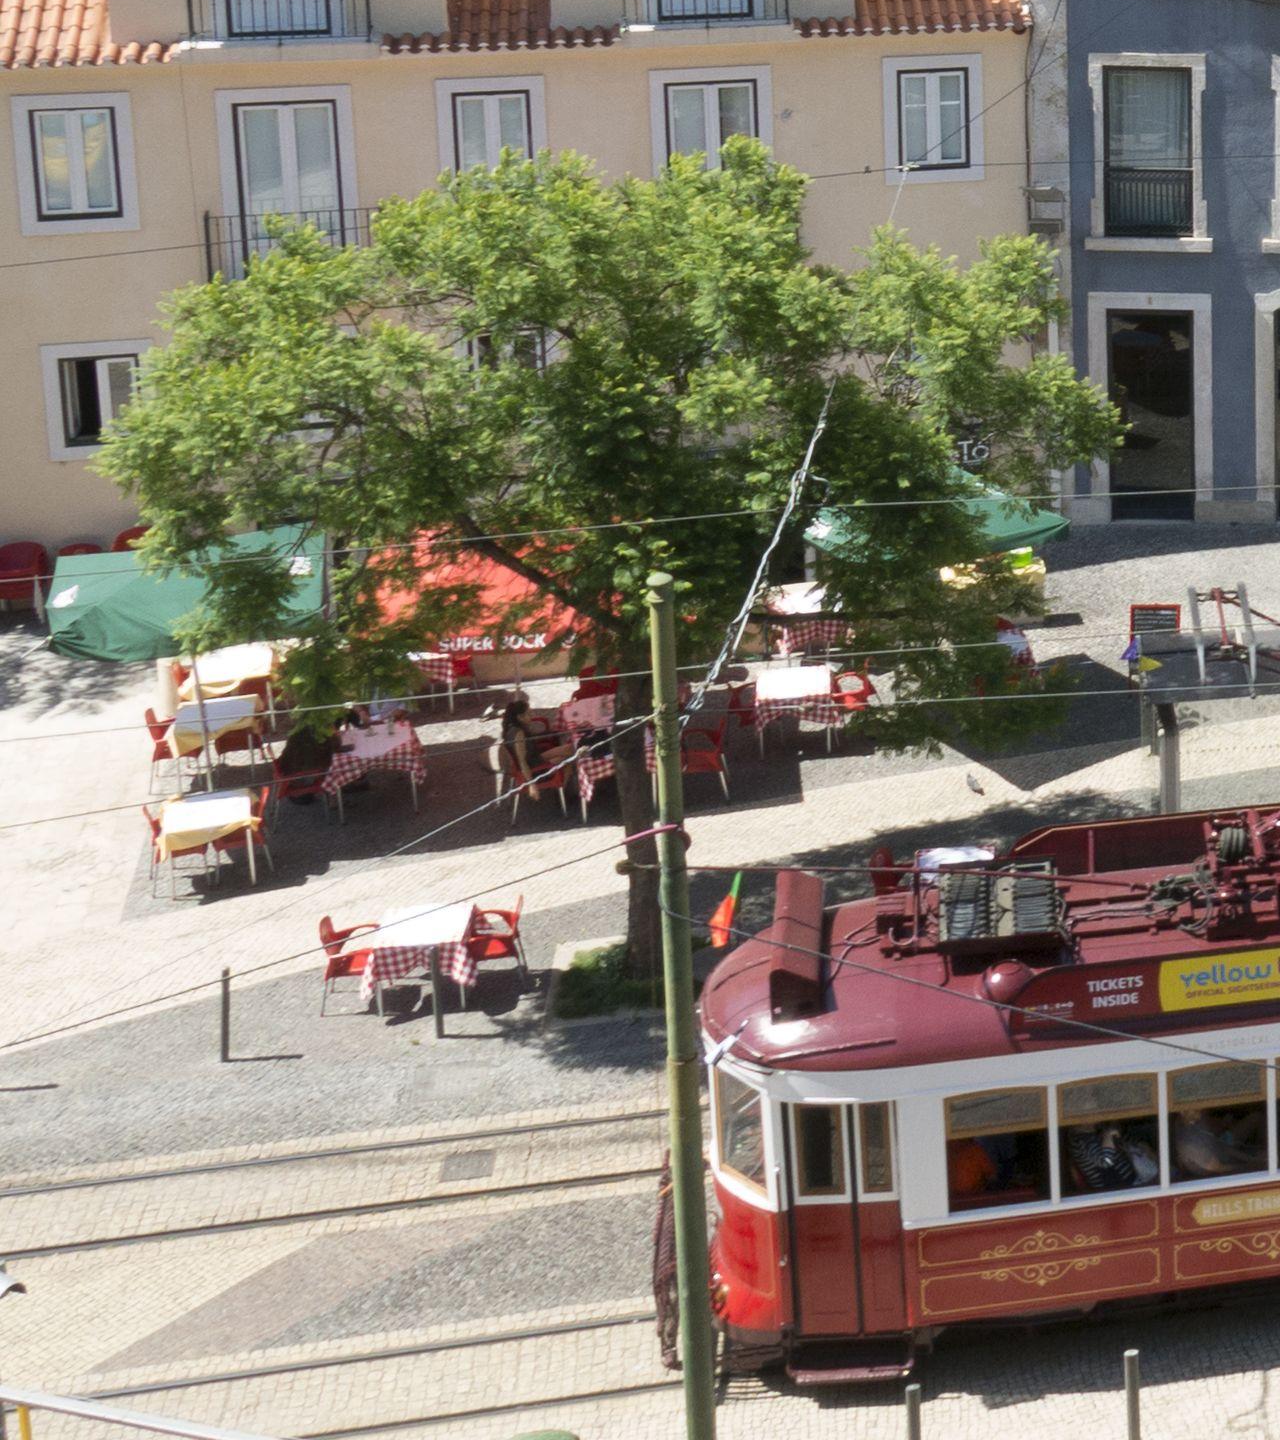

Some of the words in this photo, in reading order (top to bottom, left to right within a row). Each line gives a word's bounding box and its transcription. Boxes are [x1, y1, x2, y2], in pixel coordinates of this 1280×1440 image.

[438, 635, 495, 652] SUPER
[1087, 975, 1144, 993] TICKETS
[1092, 992, 1140, 1009] INSIDE
[1185, 987, 1226, 1000] OFFICIAL
[1202, 1200, 1243, 1218] HILLS
